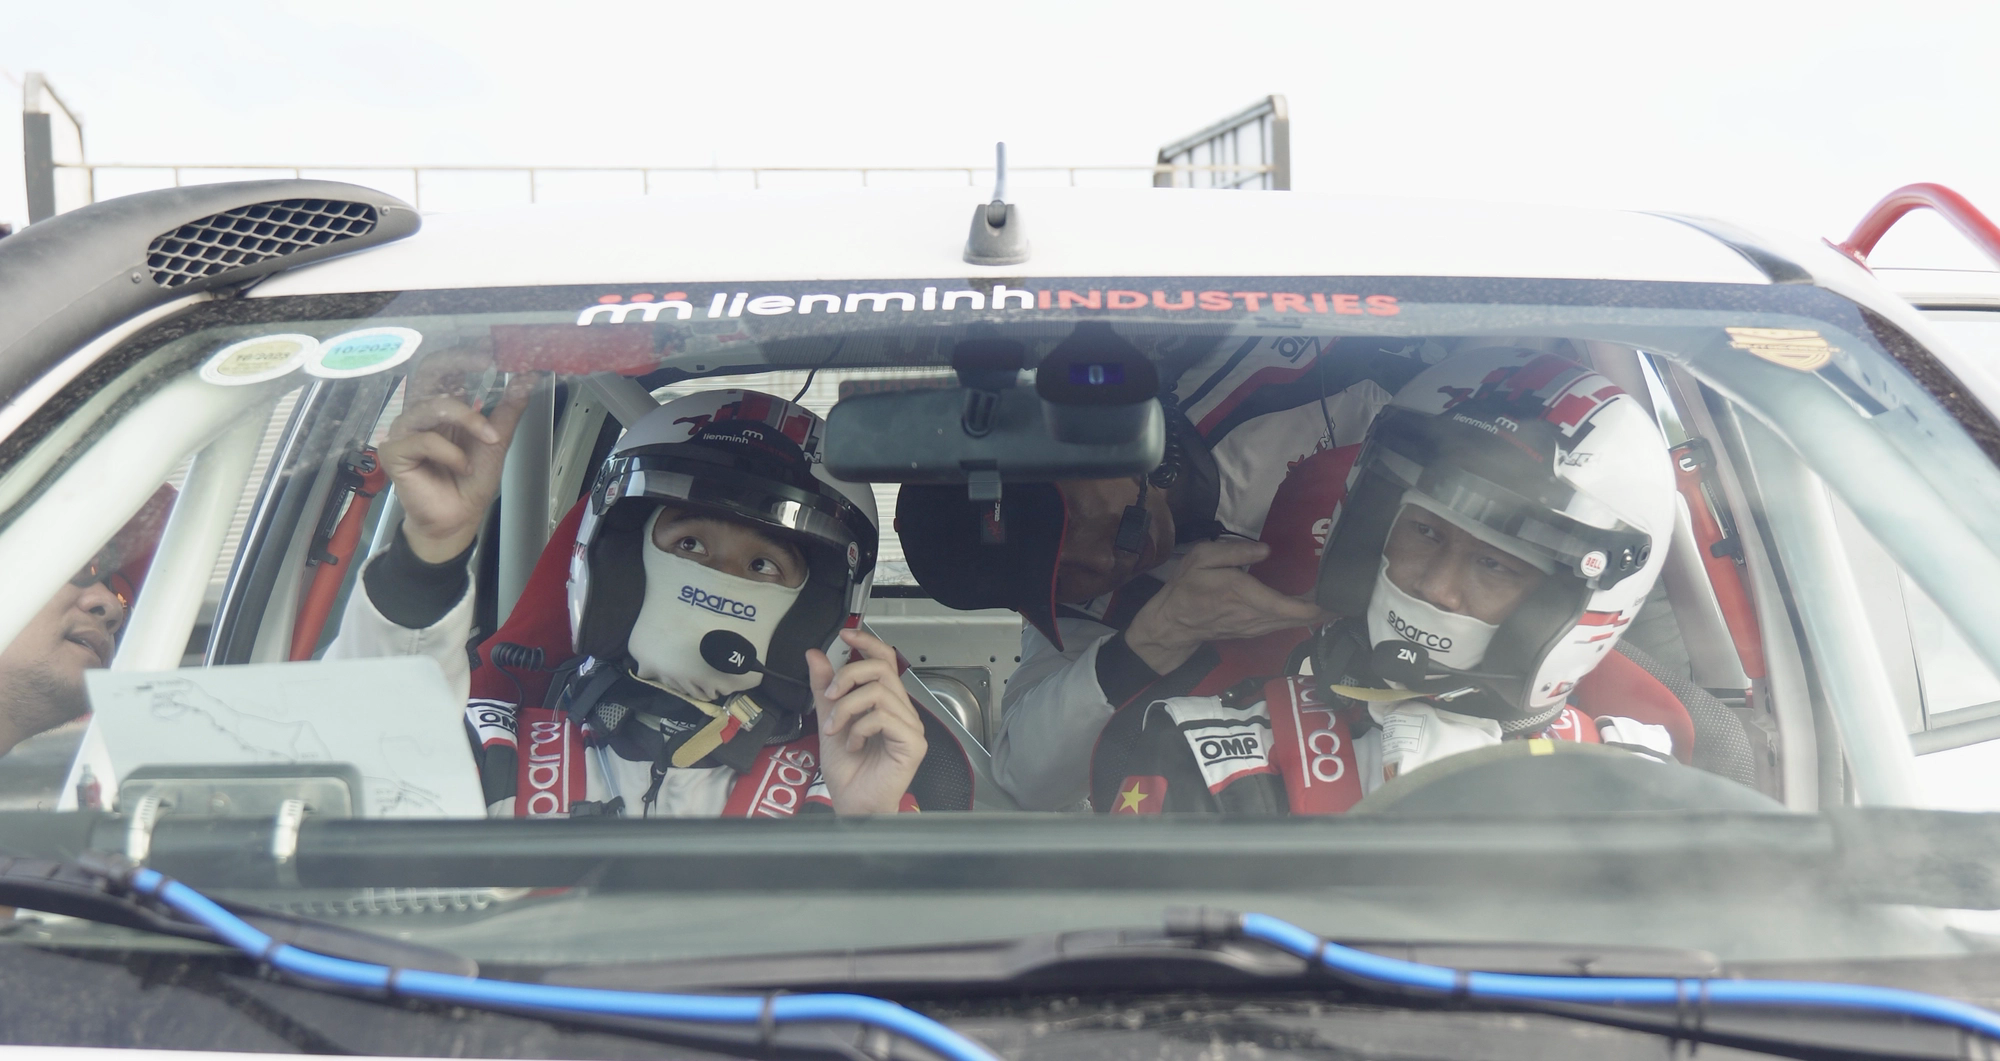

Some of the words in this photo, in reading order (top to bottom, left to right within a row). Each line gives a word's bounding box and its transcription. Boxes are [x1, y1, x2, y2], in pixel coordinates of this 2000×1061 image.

[1585, 556, 1601, 570] BELL
[680, 585, 757, 621] sparco
[1387, 610, 1453, 652] sparco
[1200, 737, 1259, 760] OMP
[527, 721, 571, 819] parco
